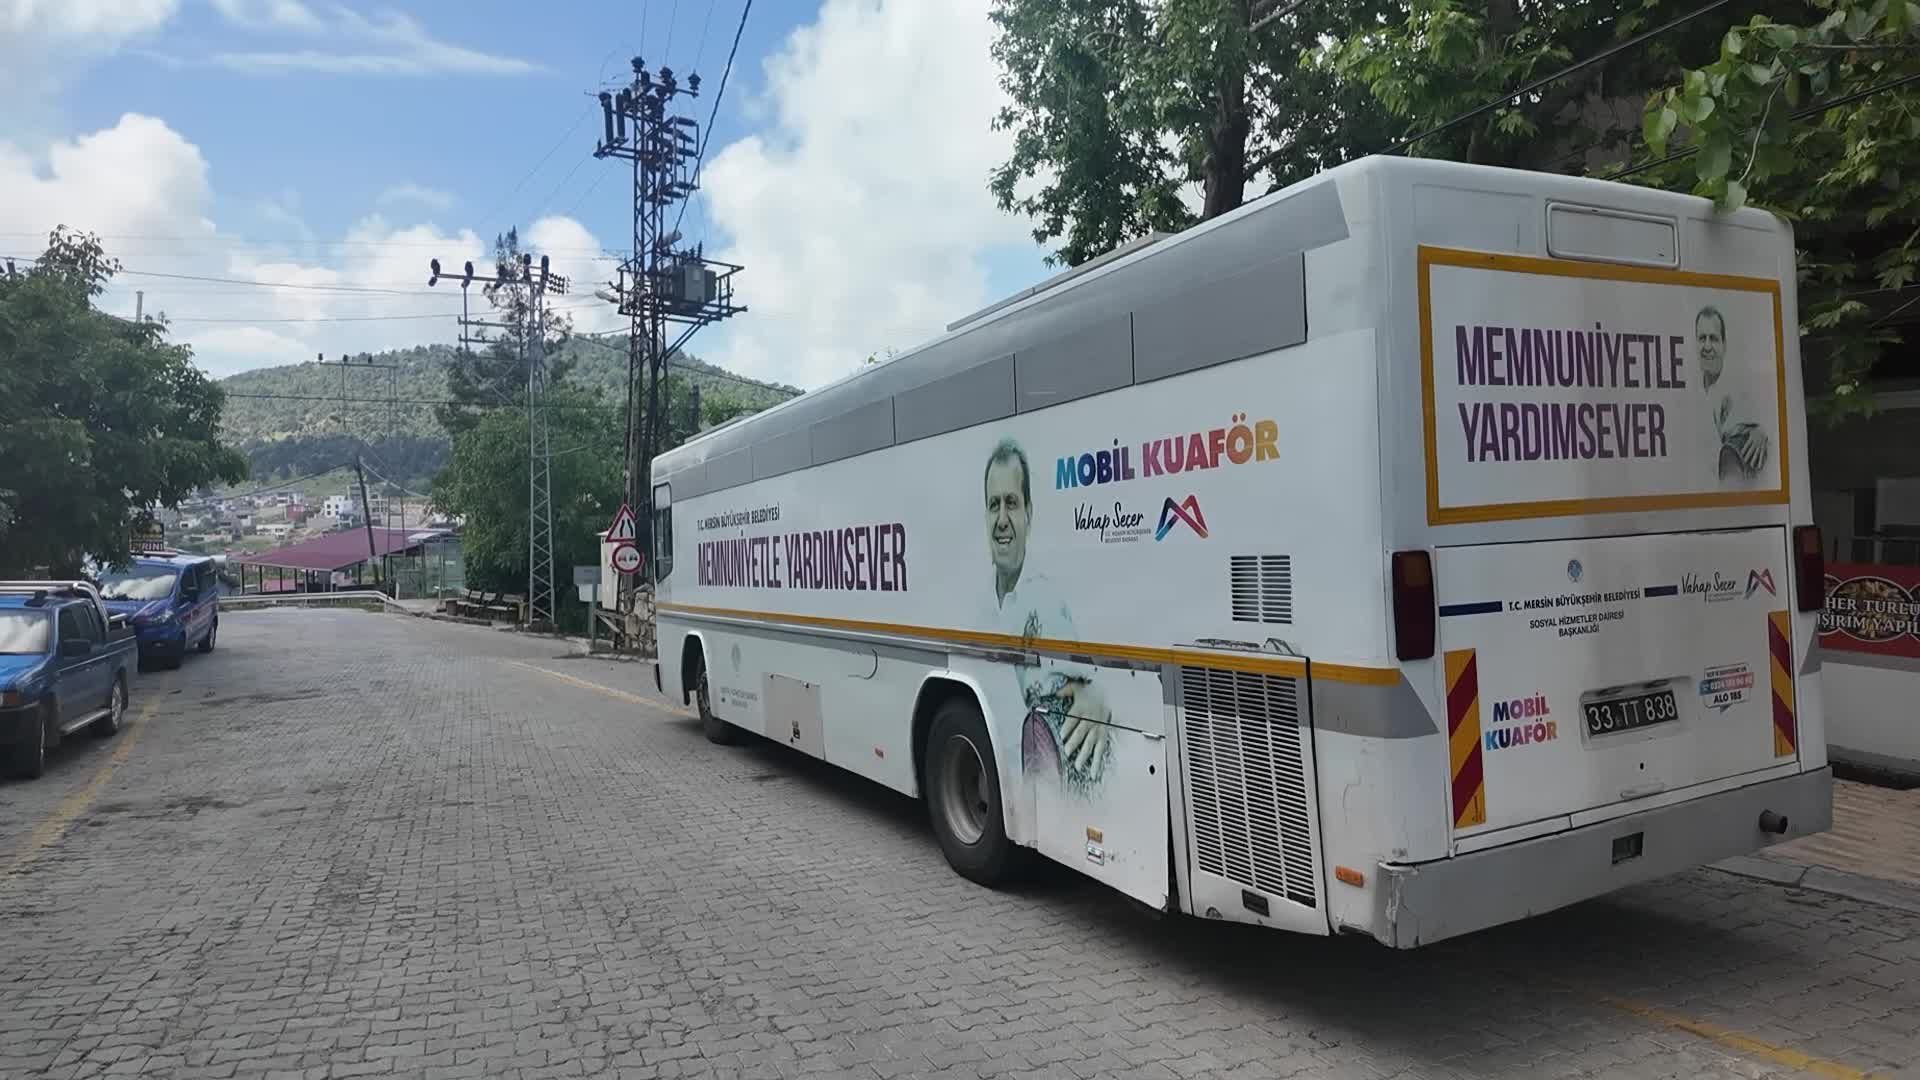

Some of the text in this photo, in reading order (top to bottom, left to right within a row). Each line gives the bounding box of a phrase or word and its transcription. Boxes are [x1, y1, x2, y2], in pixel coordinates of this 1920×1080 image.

[1455, 322, 1686, 389] MEMNUNİYETLE
[1458, 402, 1667, 462] YARDIMSEVER
[1056, 412, 1280, 489] MOBİL KUAFÖR
[751, 502, 780, 524] BELEDİYESİ
[1074, 501, 1111, 543] Vahap
[698, 523, 907, 591] MEMNUNİYETLE YARDIMSEVER
[1509, 588, 1640, 611] T.C. MERSİN BÜYÜKŞEHİR BELEDİYESİ
[1682, 573, 1711, 603] Vahap
[1825, 597, 1857, 610] HER
[1530, 610, 1624, 629] SOSYAL HİZMETLER DAİRESİ
[1558, 624, 1600, 637] BAŞKANLIĞI
[1493, 692, 1550, 722] MOBİL
[1589, 694, 1676, 731] 33 TT 838
[1714, 692, 1729, 704] ALO
[1485, 718, 1558, 751] KUAFÖR
